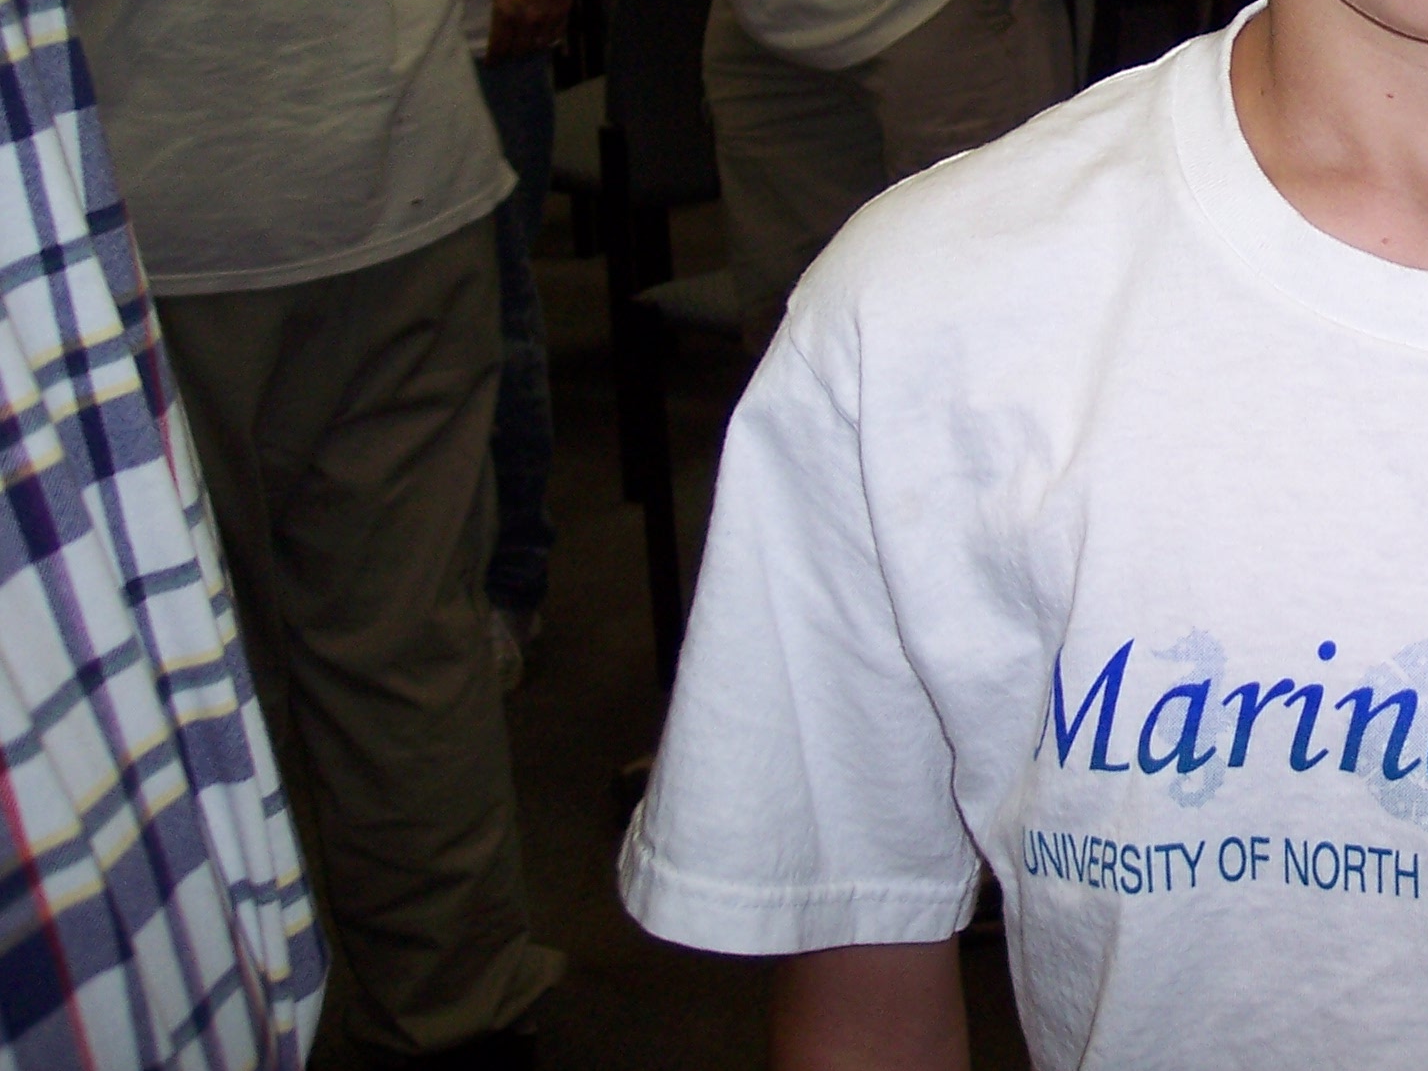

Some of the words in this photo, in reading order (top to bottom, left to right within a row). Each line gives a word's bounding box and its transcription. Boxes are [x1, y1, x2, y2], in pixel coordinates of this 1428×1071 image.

[1022, 826, 1206, 894] UNIVERSITY
[1218, 836, 1270, 882] OF
[1284, 837, 1419, 899] NORTH
